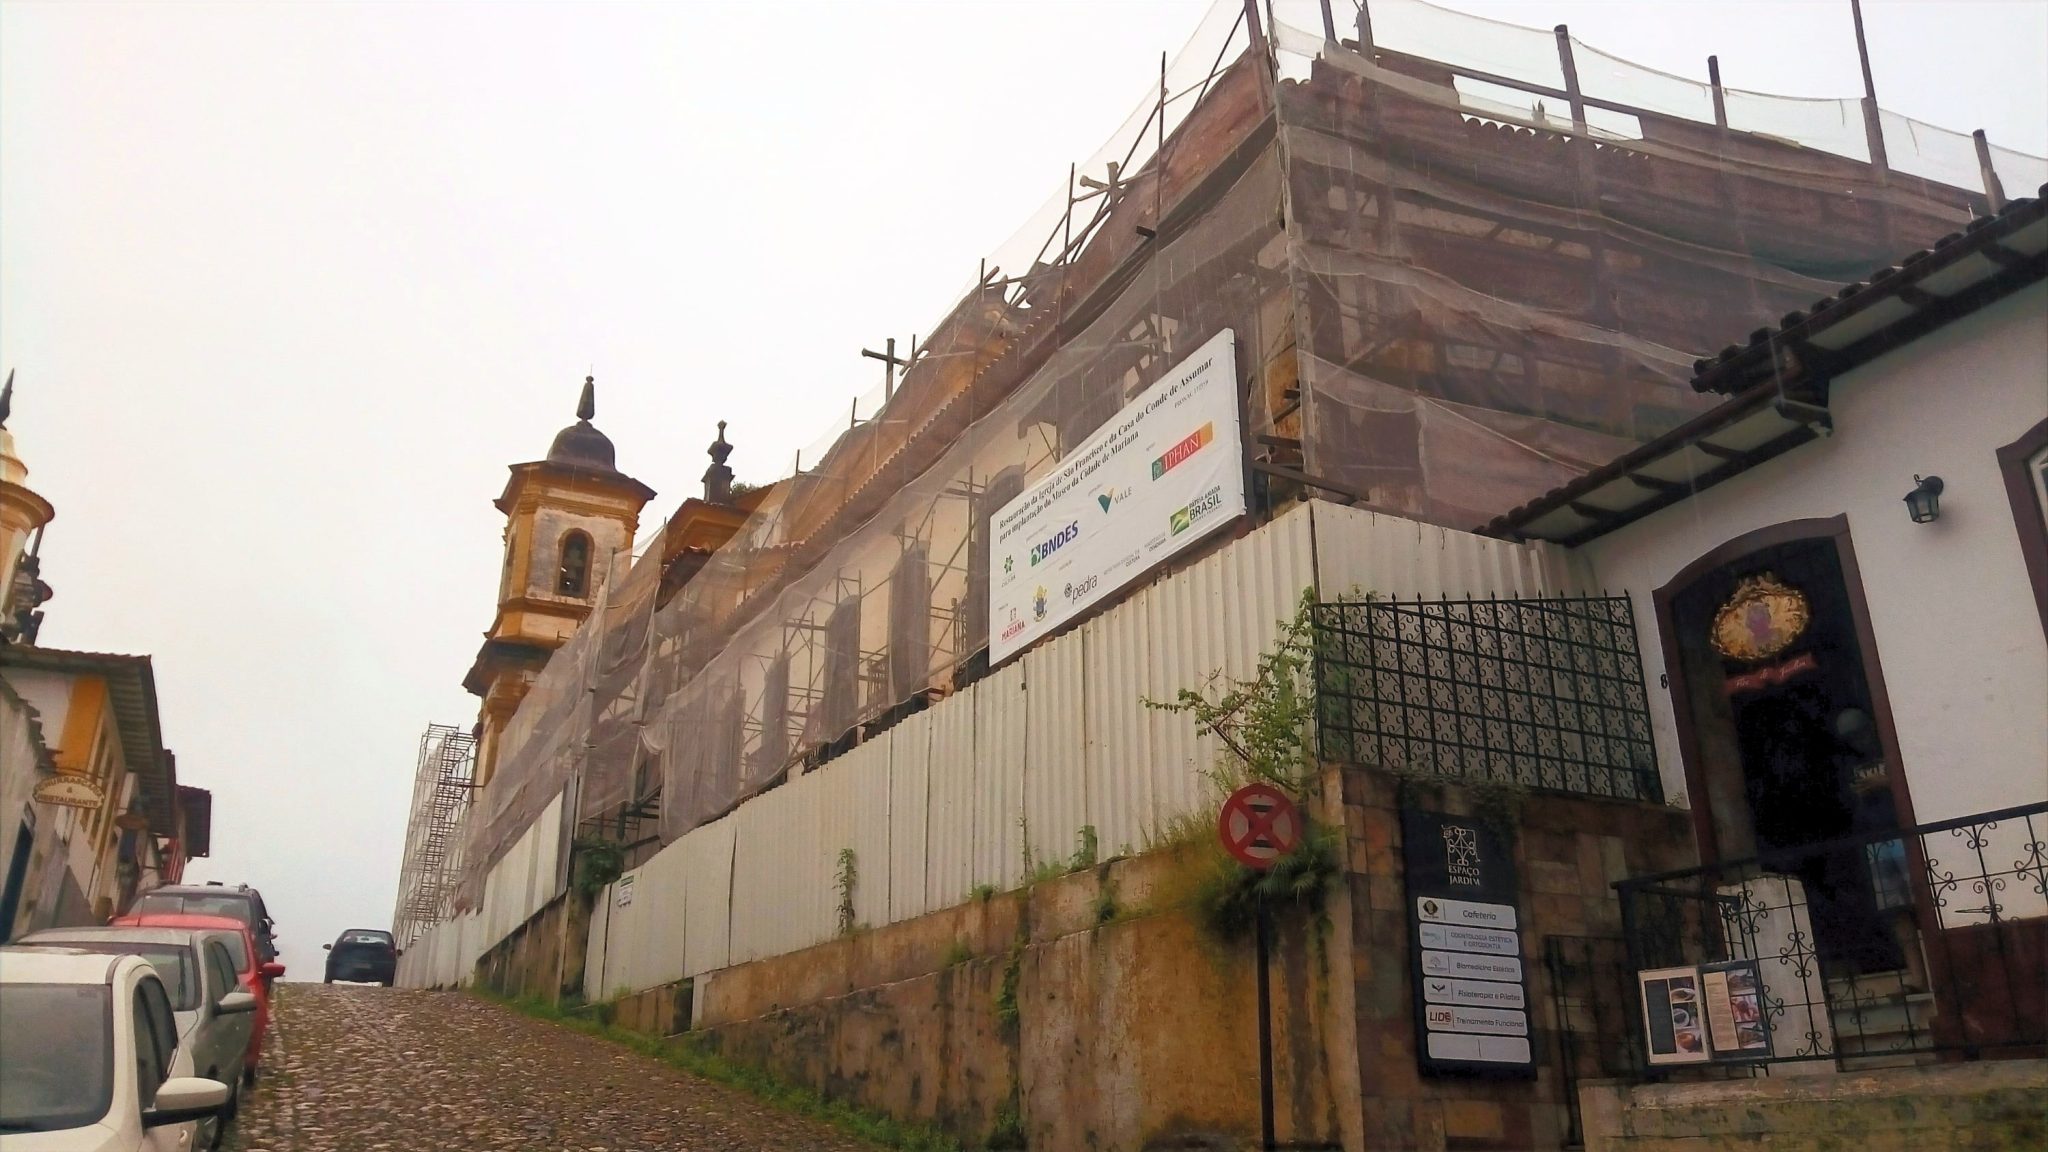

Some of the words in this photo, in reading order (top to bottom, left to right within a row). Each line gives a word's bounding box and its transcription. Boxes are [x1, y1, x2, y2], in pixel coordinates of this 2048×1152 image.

[999, 502, 1030, 529] Restauração
[1031, 495, 1038, 506] da
[1039, 482, 1055, 500] Igreja
[1055, 475, 1063, 486] de
[1063, 467, 1075, 480] São
[1075, 445, 1104, 471] Francisco
[1109, 432, 1117, 444] da
[1118, 420, 1135, 436] Casa
[1145, 393, 1168, 415] Conde
[1169, 384, 1178, 396] de
[1180, 357, 1213, 387] Assumar
[1164, 433, 1200, 470] IPHAN
[999, 529, 1011, 544] para
[1012, 505, 1043, 531] implantação
[1044, 498, 1052, 508] do
[1052, 484, 1071, 503] Museu
[1071, 477, 1079, 487] da
[1080, 461, 1101, 480] Cidade
[1101, 453, 1110, 464] de
[1110, 430, 1139, 455] Mariana
[1114, 486, 1132, 504] VALE
[1189, 493, 1222, 521] BRASIL
[1041, 519, 1079, 560] BNDES
[1072, 575, 1098, 605] pedra
[1001, 620, 1025, 641] MARIANA
[1448, 865, 1480, 877] ESPAÇO
[1449, 875, 1480, 886] JARDIM
[1462, 909, 1497, 920] Cafeteria
[1450, 931, 1488, 941] ODONTOLOGIA
[1468, 941, 1502, 950] ORTODONTIA
[1456, 962, 1492, 971] Biomedicina
[1458, 989, 1494, 999] Fisioterapia
[1456, 1016, 1495, 1026] Treinamento
[1495, 1019, 1525, 1028] Funcional
